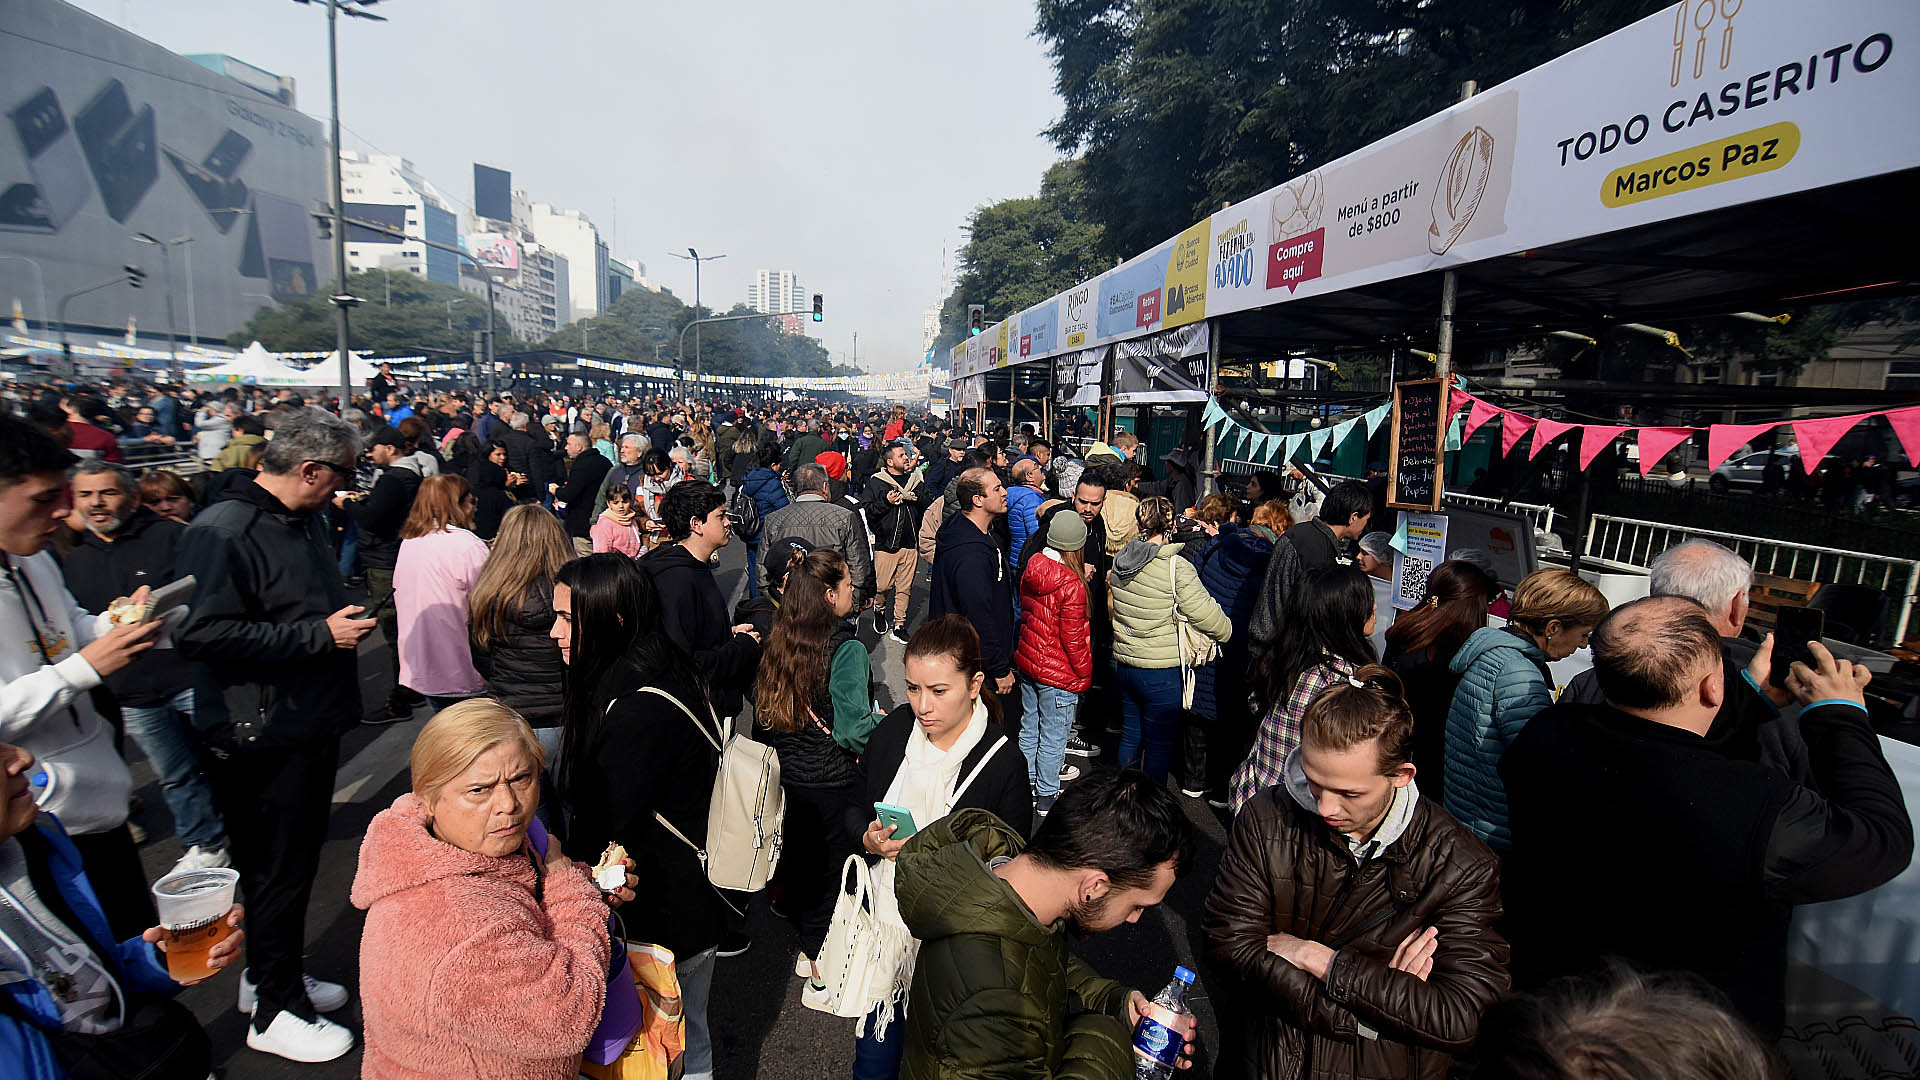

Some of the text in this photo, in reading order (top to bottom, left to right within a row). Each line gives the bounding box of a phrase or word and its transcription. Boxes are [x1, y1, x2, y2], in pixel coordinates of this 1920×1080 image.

[1557, 32, 1894, 167] TODO CASERITO
[1614, 138, 1780, 199] Marcos Paz
[1337, 180, 1420, 223] Menú a partir
[1348, 208, 1401, 238] de $800
[1276, 240, 1314, 262] Compre
[1214, 247, 1254, 289] ASADO
[1282, 260, 1305, 281] aquí
[1067, 288, 1089, 321] RINGO
[1142, 296, 1155, 308] Retire
[1167, 283, 1186, 316] BA
[1188, 359, 1205, 377] CAJA
